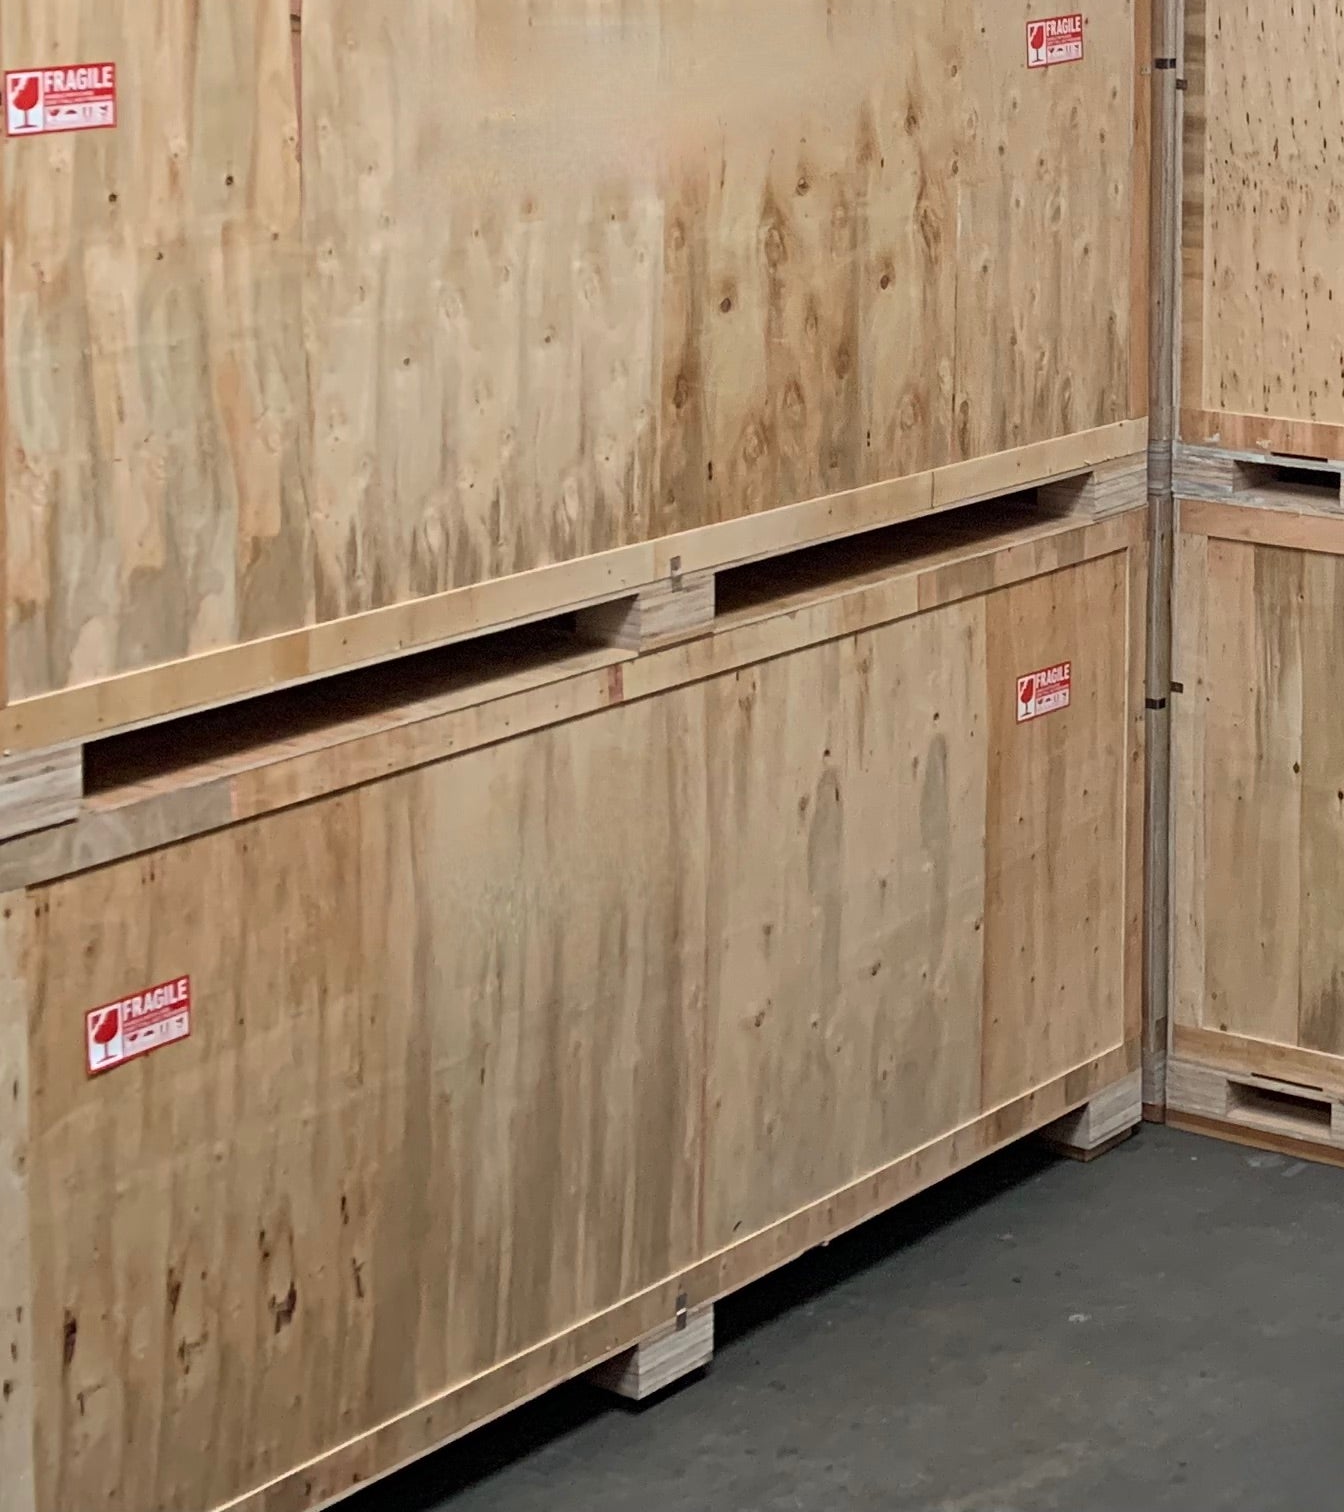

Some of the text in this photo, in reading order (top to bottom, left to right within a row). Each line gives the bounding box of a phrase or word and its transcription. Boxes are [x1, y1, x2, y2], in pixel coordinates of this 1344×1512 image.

[1047, 17, 1080, 36] FRAGILE
[44, 66, 112, 90] FRAGILE
[1036, 664, 1070, 688] FRAGILE
[123, 980, 187, 1021] FRAGILE
